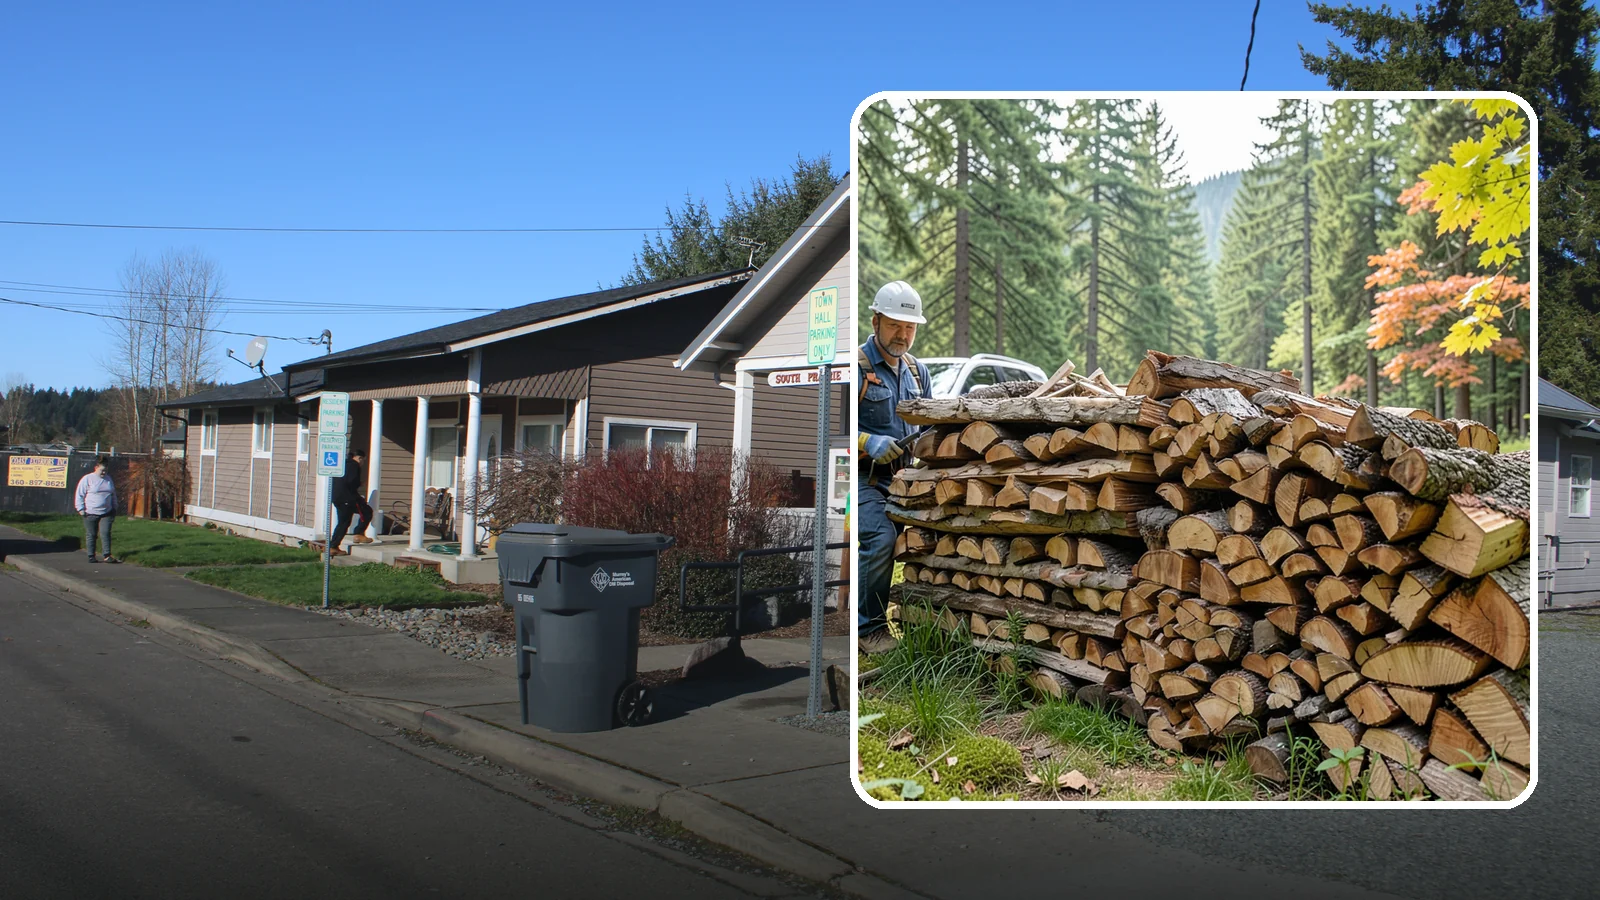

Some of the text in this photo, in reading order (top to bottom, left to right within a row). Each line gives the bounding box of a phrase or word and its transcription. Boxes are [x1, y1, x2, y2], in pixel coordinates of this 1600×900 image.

[815, 295, 833, 308] TOWN
[814, 311, 831, 324] HALL
[810, 326, 836, 341] PARKING
[814, 344, 831, 357] ONLY
[775, 373, 801, 384] SOUTH
[807, 370, 842, 382] PRIE
[323, 409, 345, 417] PARKING
[320, 436, 344, 444] RESERVED
